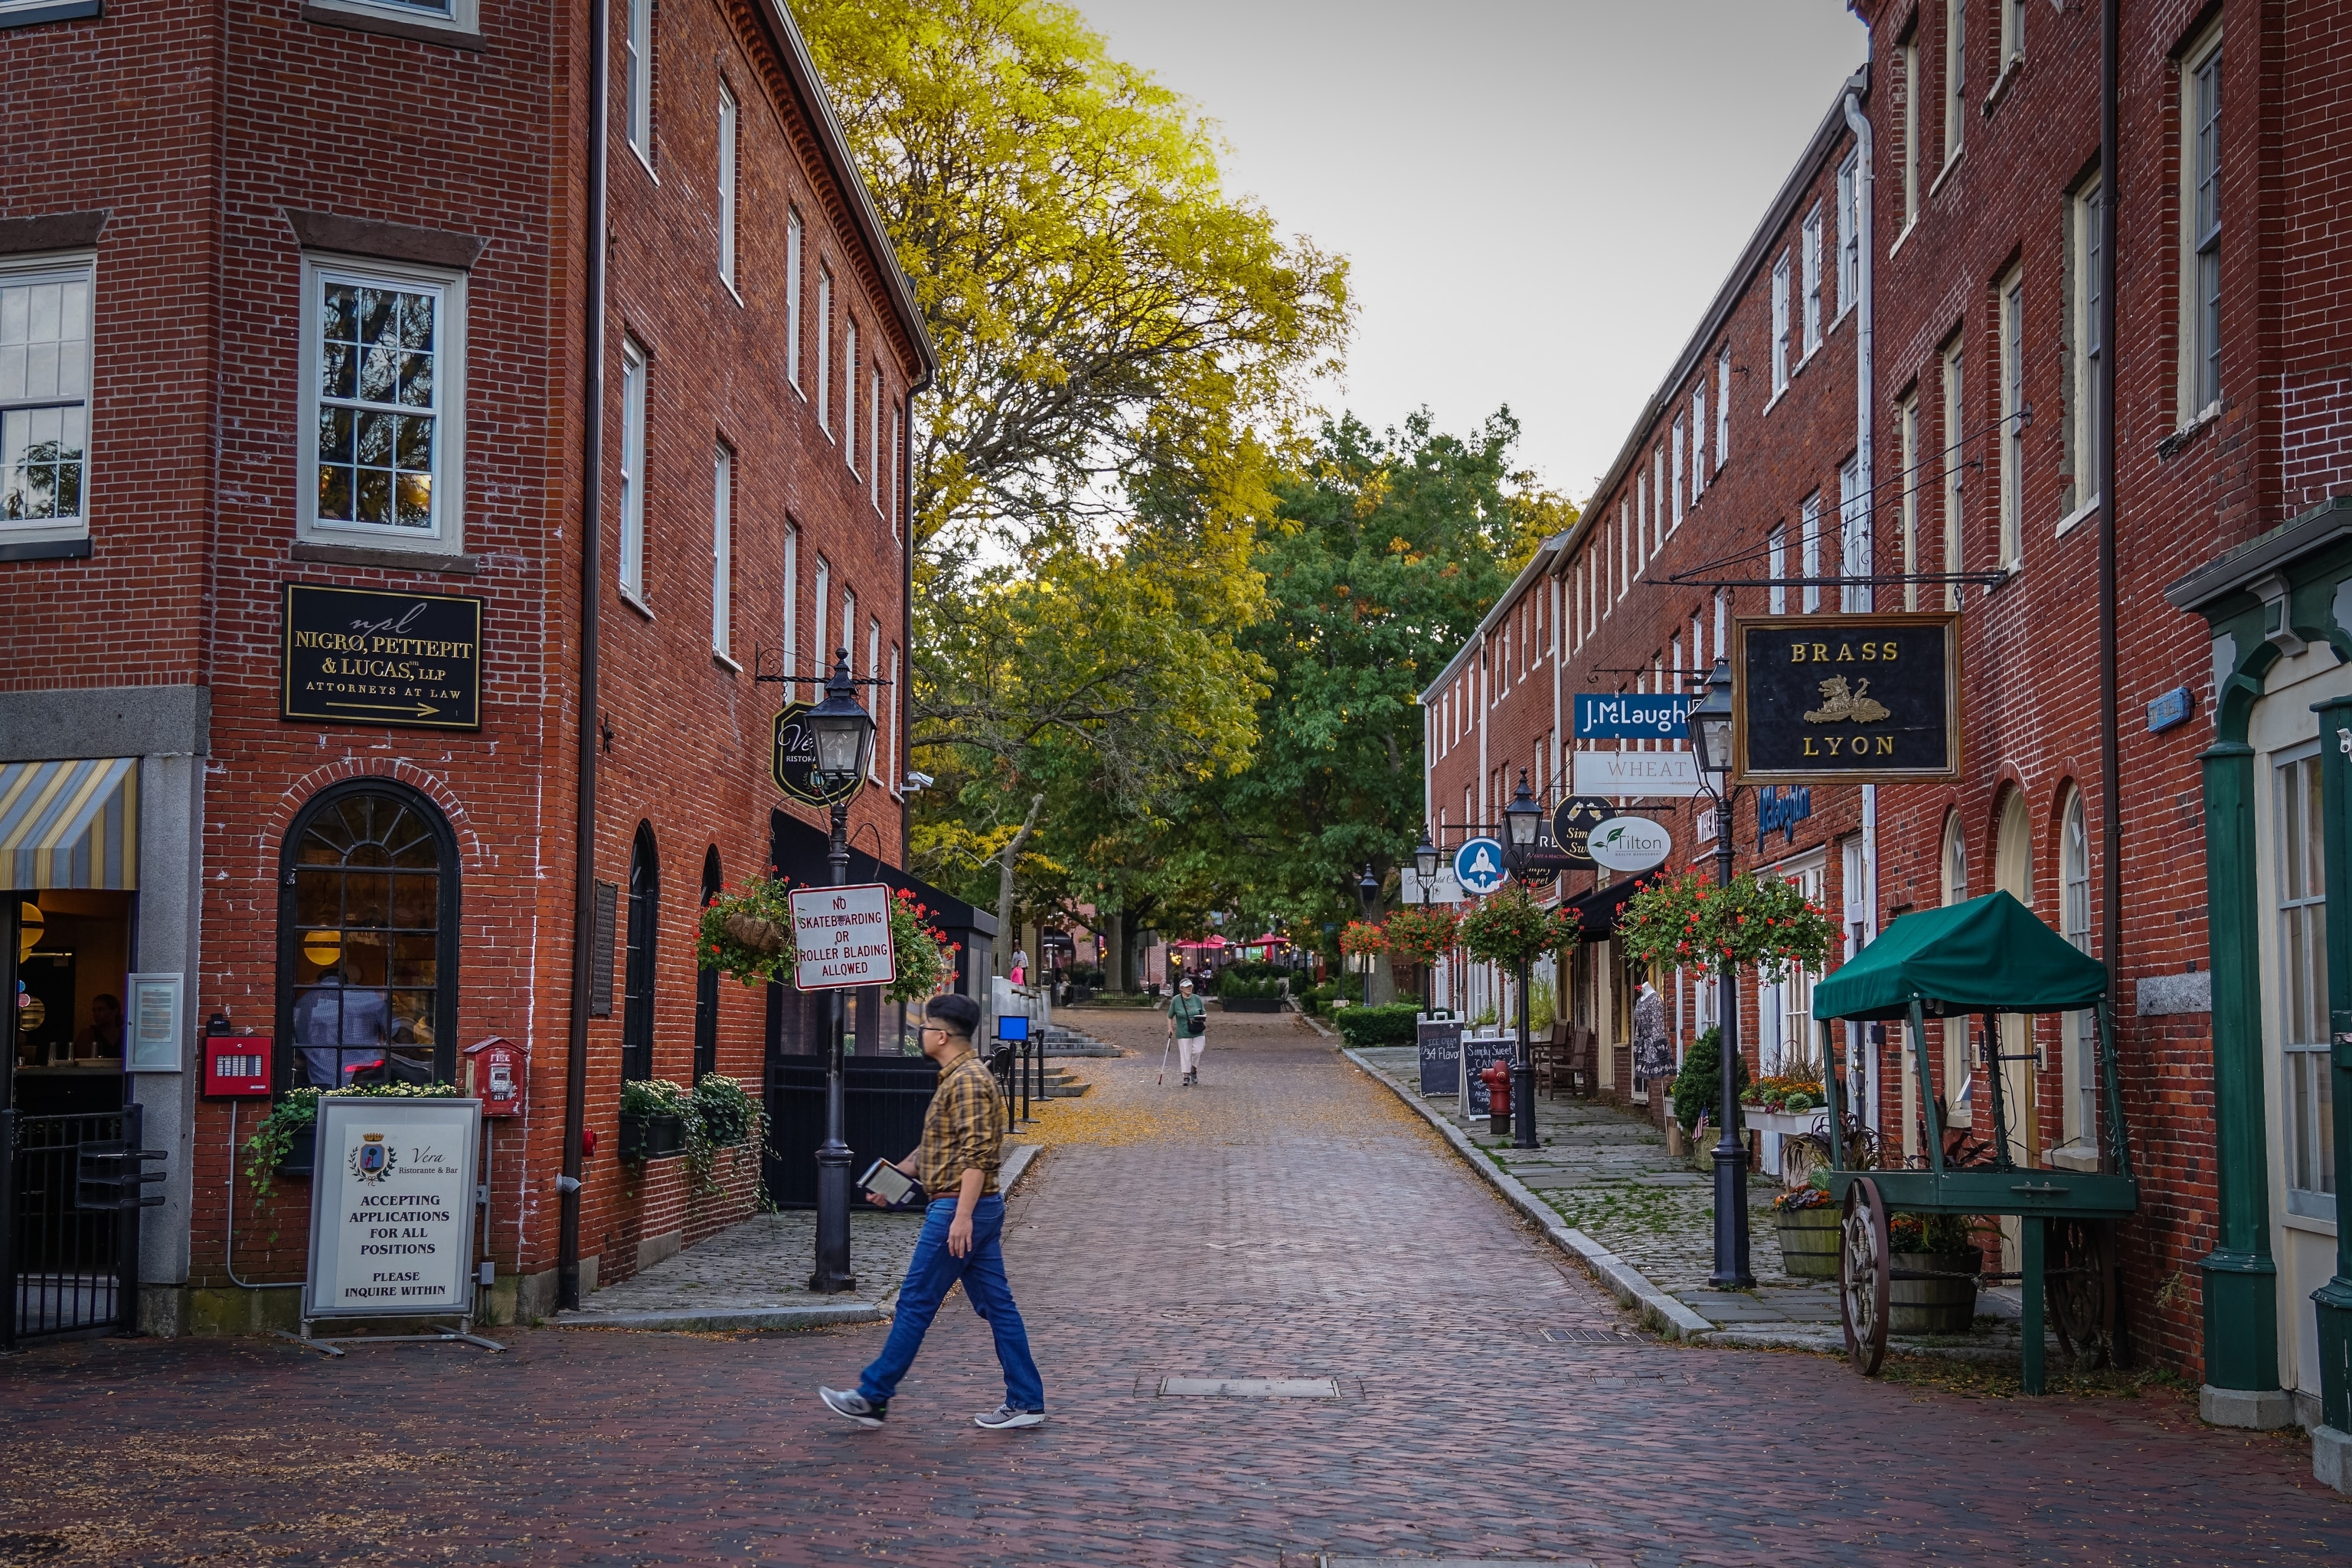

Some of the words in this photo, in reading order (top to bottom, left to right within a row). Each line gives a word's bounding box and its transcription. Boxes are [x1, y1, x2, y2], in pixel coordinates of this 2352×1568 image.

[295, 630, 368, 655] NIGRO,
[371, 636, 473, 659] PETTEPIT
[1791, 642, 1899, 663] BRASS
[322, 657, 337, 674] &
[341, 658, 415, 681] LUCAS,
[419, 668, 446, 681] LLP
[305, 681, 397, 695] ATTORNEYS
[404, 688, 422, 697] AT
[430, 689, 461, 699] LAW
[1803, 736, 1894, 756] LYON
[1607, 761, 1687, 777] WHEAT
[1566, 827, 1589, 839] Sim
[1615, 835, 1662, 850] Tilton
[832, 897, 847, 910] NO
[799, 911, 882, 929] SKATEBARDING
[835, 930, 849, 943] OR
[800, 948, 839, 962] ROLLER
[843, 943, 887, 959] BLADING
[822, 962, 868, 977] ALLOWED
[1467, 1044, 1491, 1060] Simply
[1492, 1044, 1513, 1056] Sweet
[411, 1145, 446, 1164] Vera
[360, 1195, 441, 1207] ACCEPTING
[348, 1210, 450, 1223] APPLICATIONS
[369, 1228, 398, 1239] FOR
[401, 1227, 429, 1238] ALL
[360, 1243, 436, 1256] POSITIONS
[372, 1272, 421, 1282] PLEASE
[345, 1286, 397, 1298] INQUIRE
[401, 1285, 446, 1296] WITHIN
